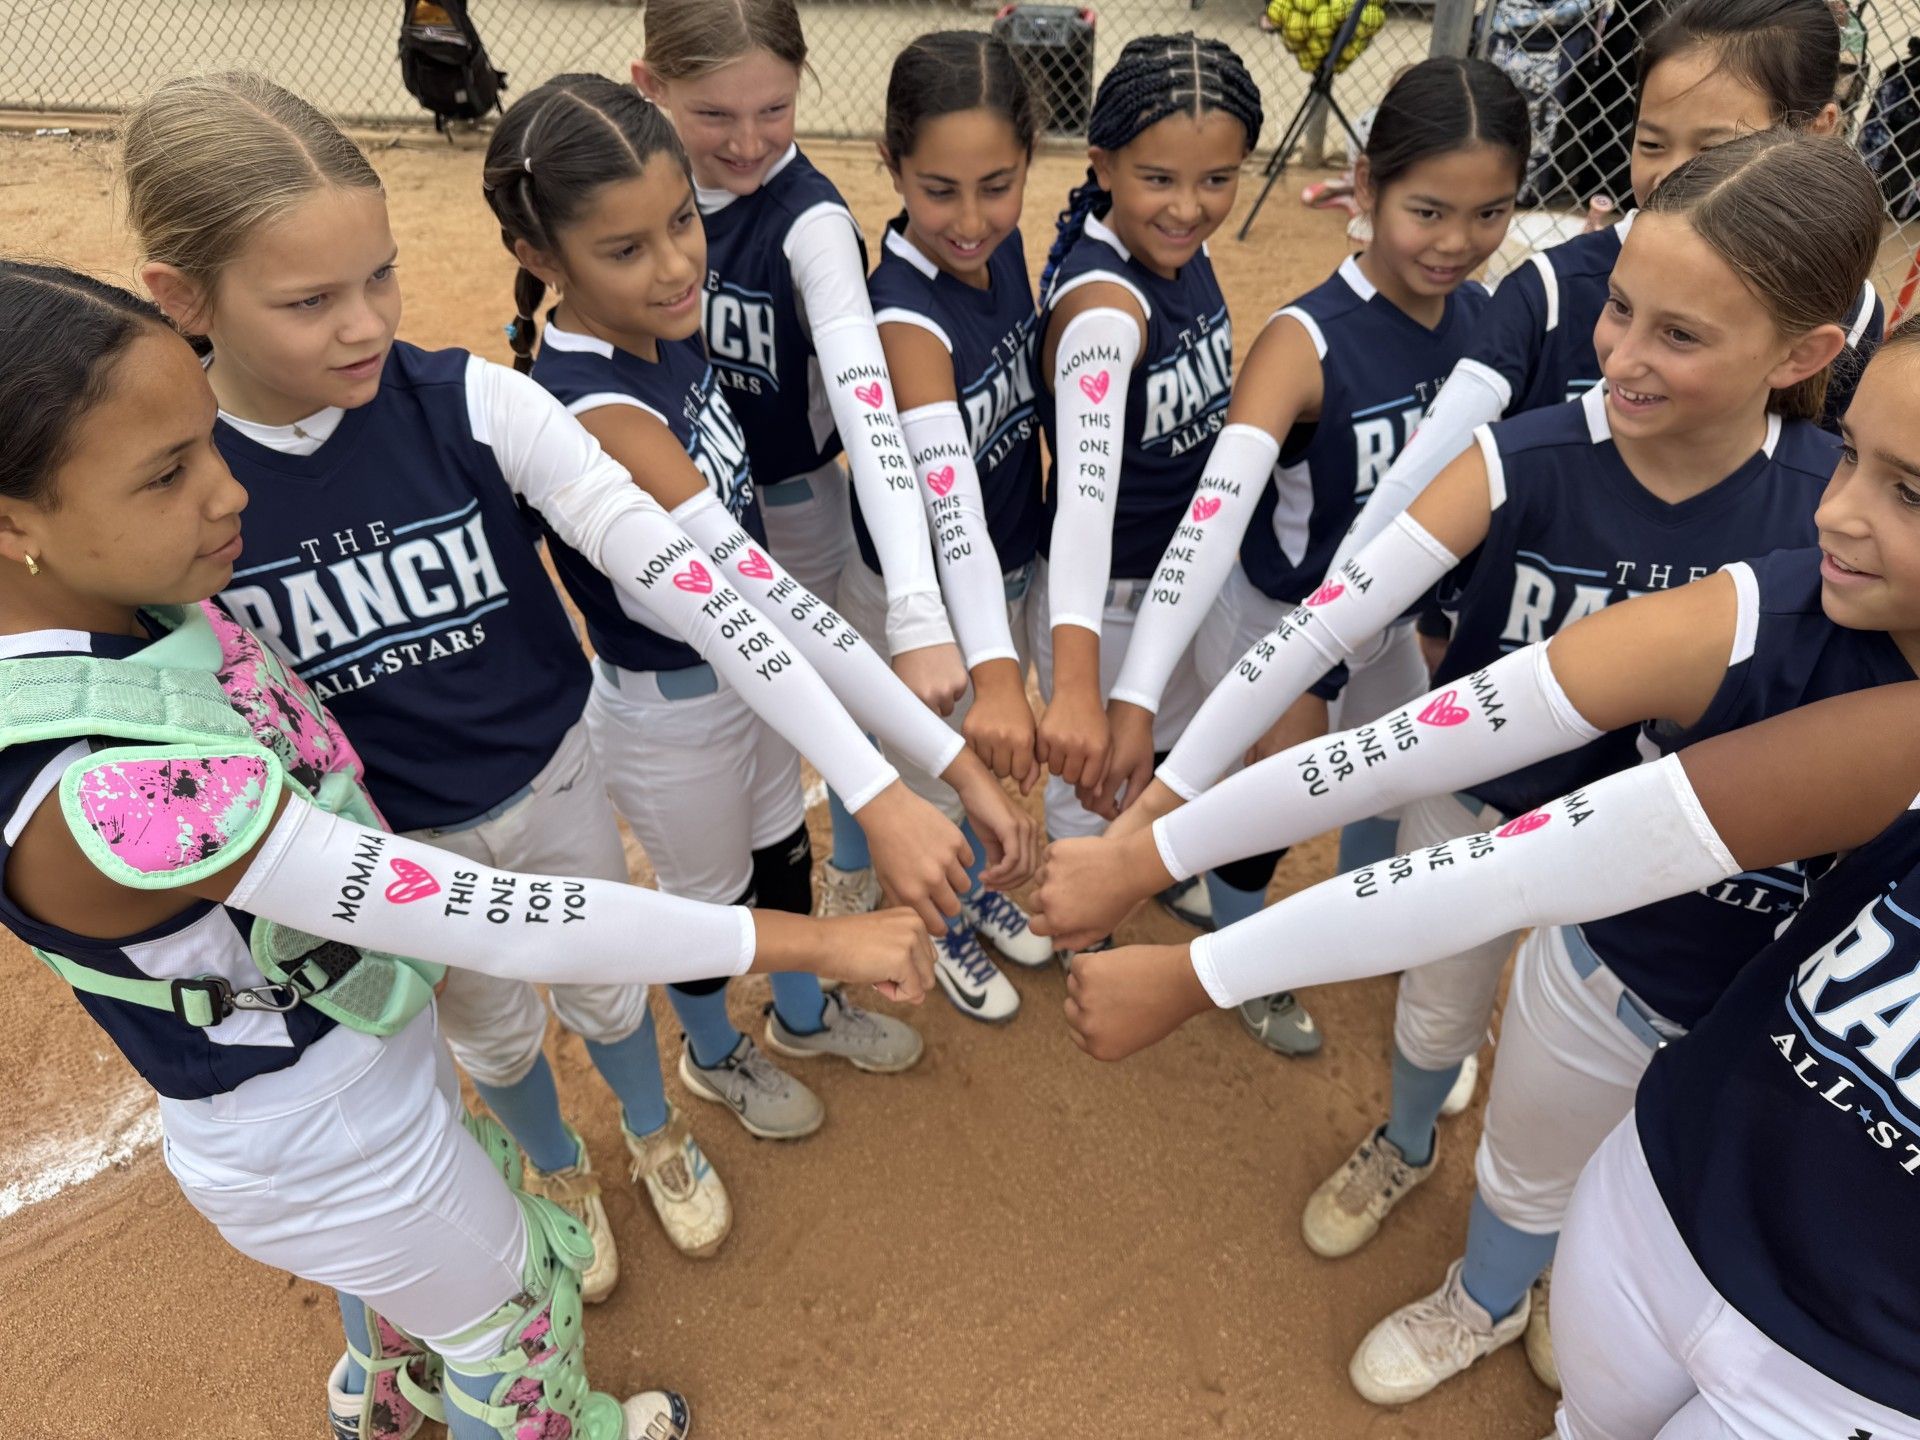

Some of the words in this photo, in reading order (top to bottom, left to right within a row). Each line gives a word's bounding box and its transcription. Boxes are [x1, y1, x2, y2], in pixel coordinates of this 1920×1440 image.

[1061, 345, 1121, 380] MOMMA
[715, 368, 761, 395] ARS
[964, 331, 1036, 458] RAN
[1142, 318, 1231, 441] RANC
[1415, 376, 1446, 402] TH
[1080, 414, 1111, 429] THIS
[871, 434, 901, 448] ONE
[913, 444, 969, 466] MOMMA
[988, 432, 1015, 472] ALL
[1080, 440, 1109, 456] ONE
[1171, 425, 1205, 457] ALL
[879, 455, 907, 469] FOR
[1080, 463, 1105, 481] FOR
[886, 476, 914, 491] YOU
[1079, 484, 1104, 502] YOU
[1199, 478, 1241, 497] OMMA
[932, 496, 960, 515] THIS
[935, 511, 962, 529] ONE
[301, 521, 391, 564] THE
[709, 530, 751, 567] MOMM
[940, 525, 966, 547] FOR
[636, 536, 698, 590] MOMMA
[944, 543, 971, 565] YOU
[1166, 547, 1196, 563] ONE
[220, 511, 508, 665] RANCH
[766, 576, 799, 605] THIS
[1158, 568, 1185, 584] FOR
[1342, 559, 1374, 595] MMA
[702, 588, 739, 620] THIS
[791, 593, 821, 622] ONE
[1152, 588, 1181, 605] YOU
[721, 608, 757, 640] ONE
[812, 610, 842, 638] FOR
[1278, 621, 1296, 641] NE
[738, 631, 775, 662] FOR
[833, 627, 860, 654] YOU
[1256, 640, 1276, 662] OR
[315, 663, 377, 701] ALL
[381, 622, 486, 675] STARS
[756, 650, 793, 682] YOU
[1468, 669, 1508, 733] OMMA
[1387, 711, 1419, 752] THIS
[1325, 740, 1354, 782] FOR
[1356, 727, 1387, 768] ONE
[1298, 753, 1330, 797] YOU
[1427, 845, 1454, 871] NE
[1467, 833, 1494, 860] HIS
[332, 834, 386, 923] MOMMA
[1389, 854, 1412, 884] OR
[444, 870, 478, 917] THIS
[486, 877, 516, 924] ONE
[525, 881, 553, 923] FOR
[562, 881, 586, 924] YOU
[1699, 883, 1772, 913] LL
[1770, 1033, 1855, 1112] ALL
